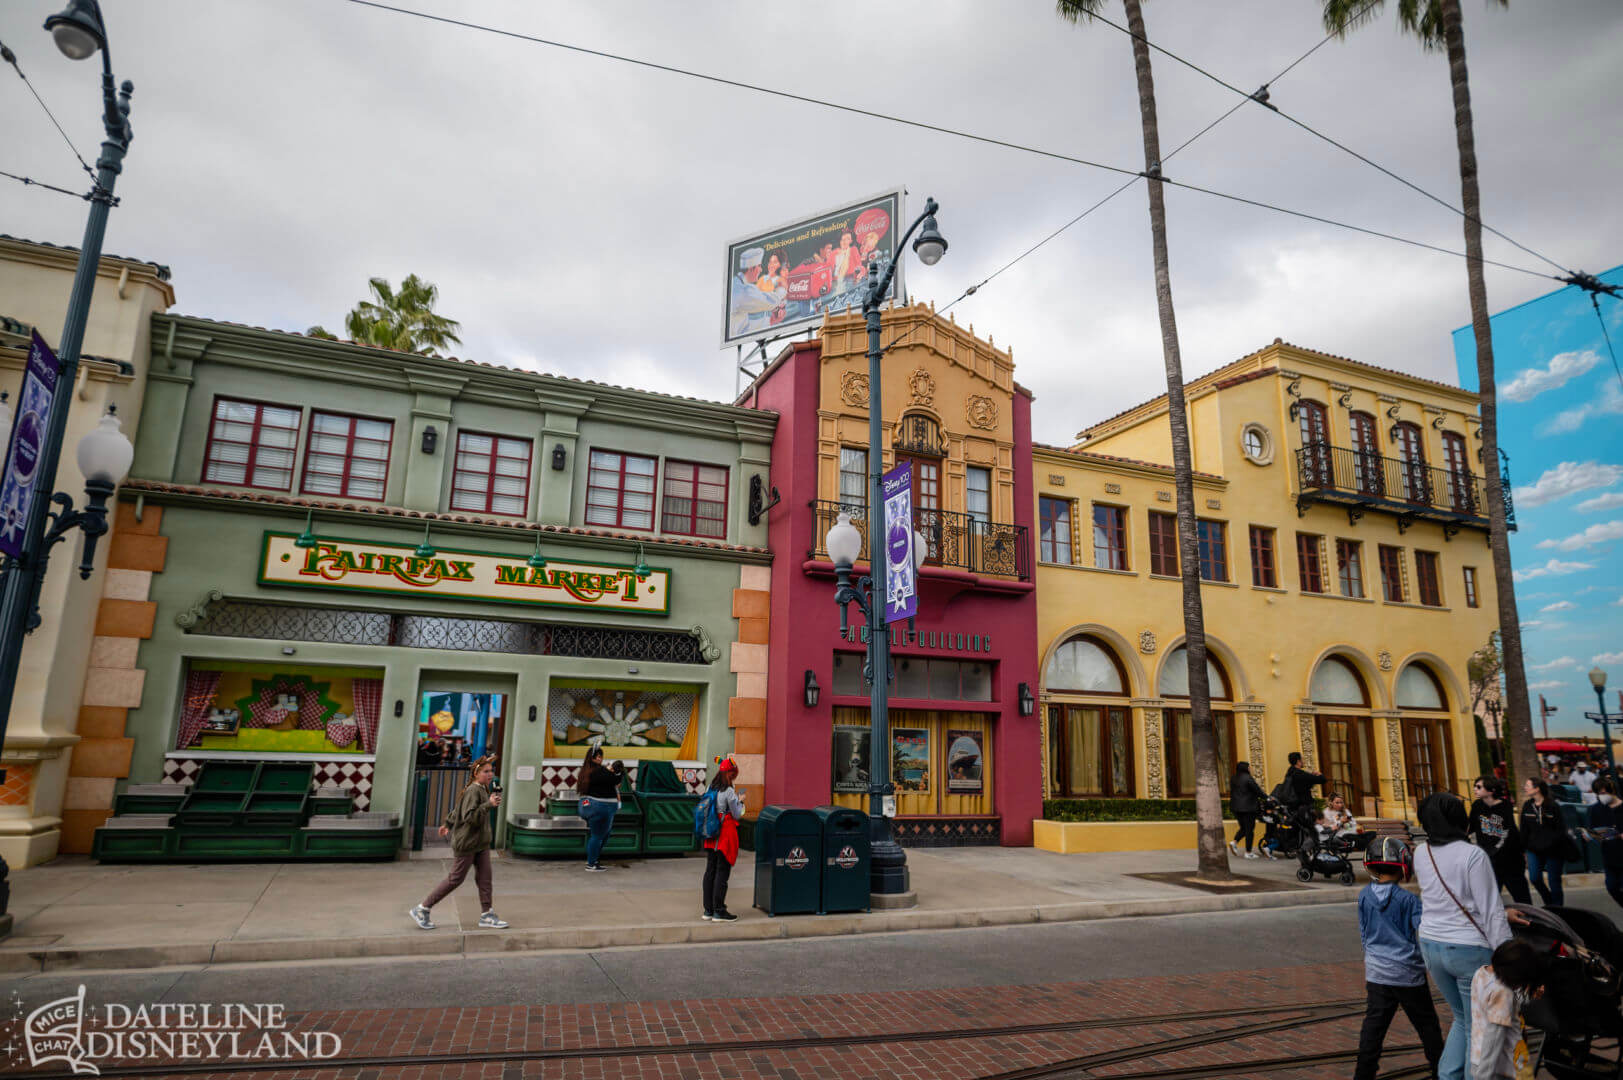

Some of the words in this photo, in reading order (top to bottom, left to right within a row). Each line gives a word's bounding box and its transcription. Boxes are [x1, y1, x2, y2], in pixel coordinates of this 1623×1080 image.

[797, 233, 810, 242] and
[298, 543, 476, 587] FAIRFAX
[495, 564, 649, 603] MARKET
[919, 631, 991, 652] BUILDING
